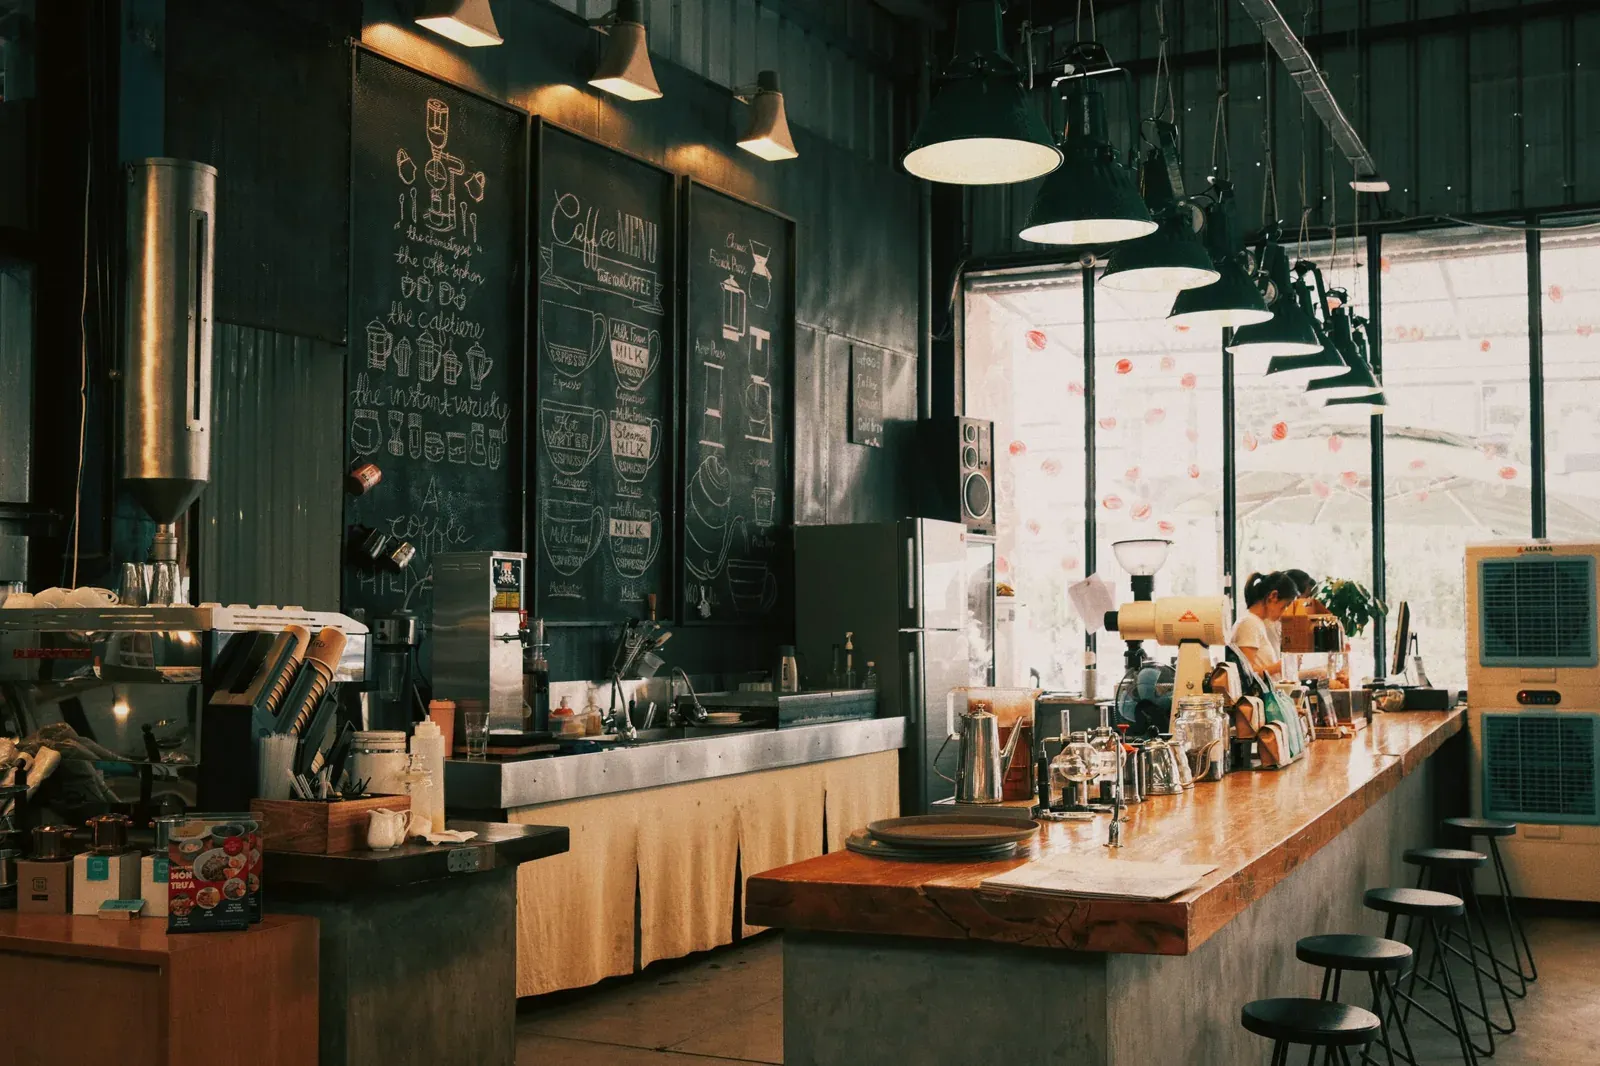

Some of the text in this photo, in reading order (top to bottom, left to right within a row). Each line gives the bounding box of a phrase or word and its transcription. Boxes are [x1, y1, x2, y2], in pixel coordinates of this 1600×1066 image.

[552, 189, 657, 271] Coffee MENU
[394, 245, 420, 268] the
[387, 300, 415, 328] the
[616, 344, 643, 363] MILK
[350, 372, 511, 444] the instant variety
[616, 440, 644, 457] MILK
[421, 475, 440, 512] A
[615, 523, 643, 536] MILK
